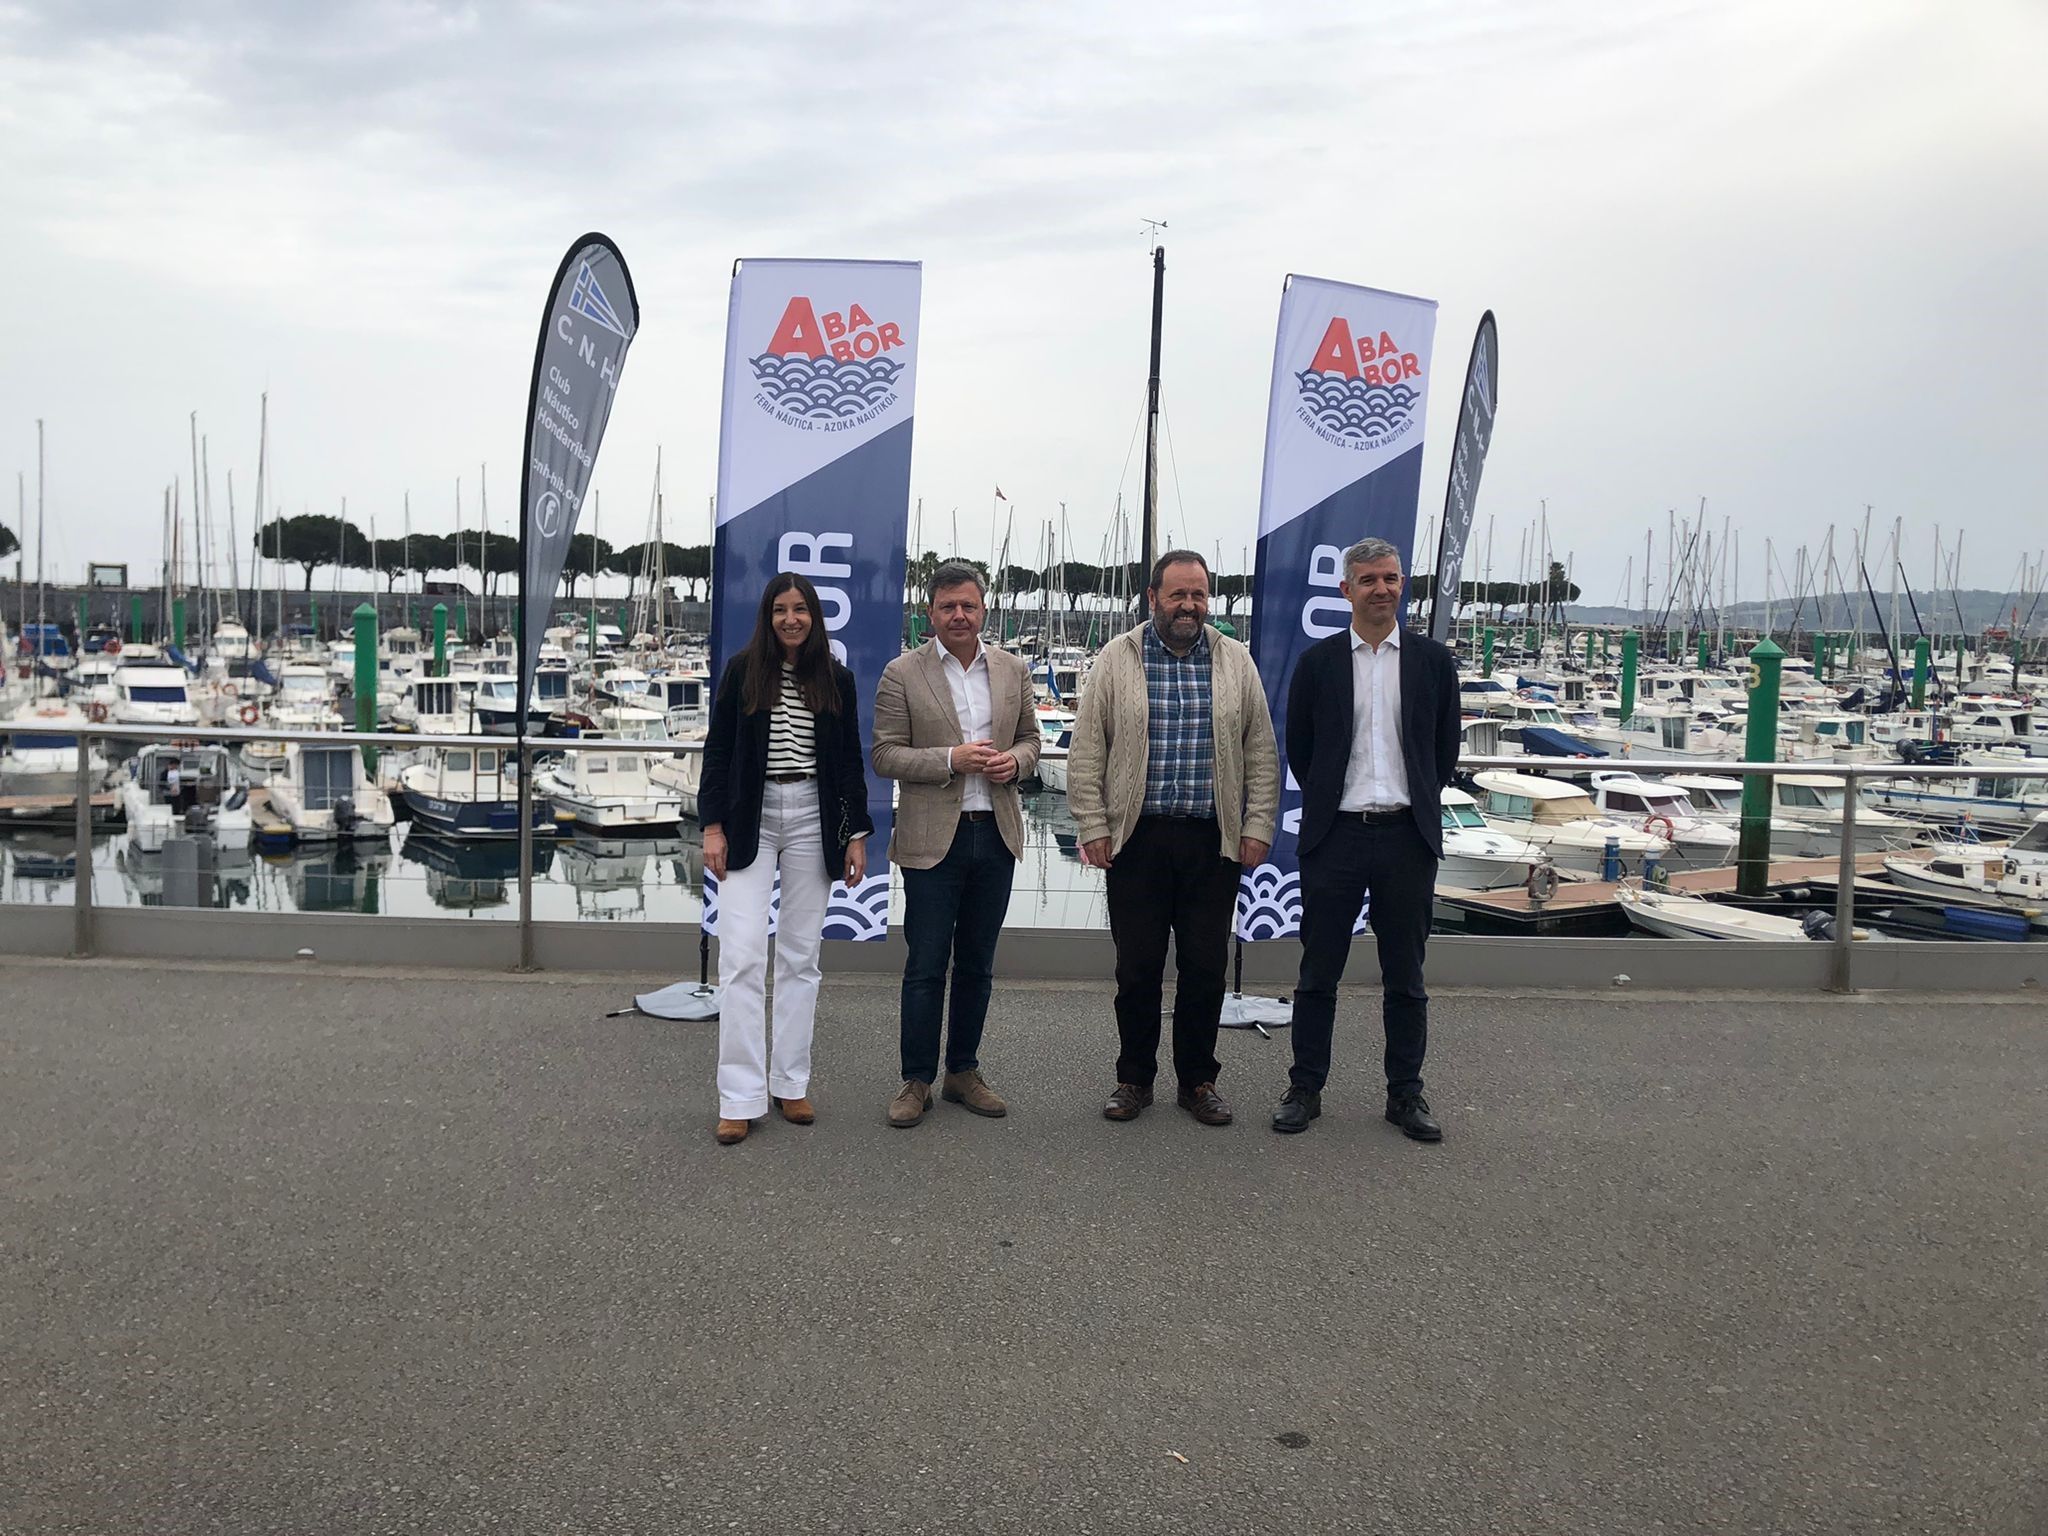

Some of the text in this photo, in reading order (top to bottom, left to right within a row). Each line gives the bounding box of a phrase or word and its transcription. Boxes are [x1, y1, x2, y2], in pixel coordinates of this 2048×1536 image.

[548, 366, 571, 396] Club
[543, 385, 579, 430] Náutico
[754, 393, 776, 416] FERIA
[775, 410, 814, 431] NÁUTICA
[824, 418, 856, 433] AZOKA
[856, 392, 899, 426] NAUTIKOA
[1296, 406, 1315, 431] FERIA
[1353, 440, 1380, 451] AZOKA
[1381, 418, 1415, 447] NAUTIKOA
